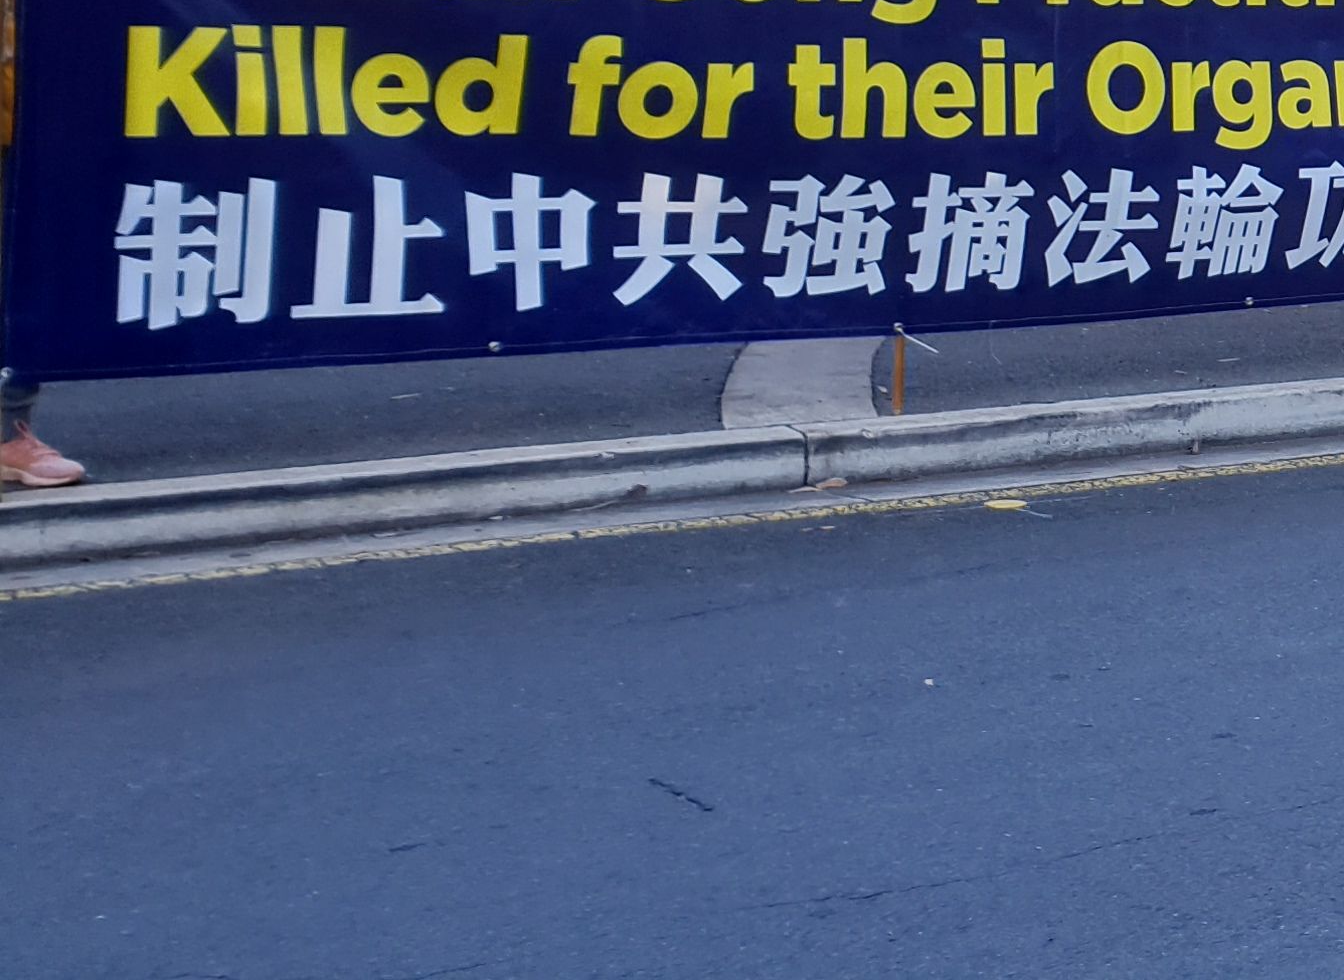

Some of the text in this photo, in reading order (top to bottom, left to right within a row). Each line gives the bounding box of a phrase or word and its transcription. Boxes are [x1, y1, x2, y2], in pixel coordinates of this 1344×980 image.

[124, 24, 529, 138] Killed
[568, 35, 754, 140] for
[787, 37, 1054, 140] their
